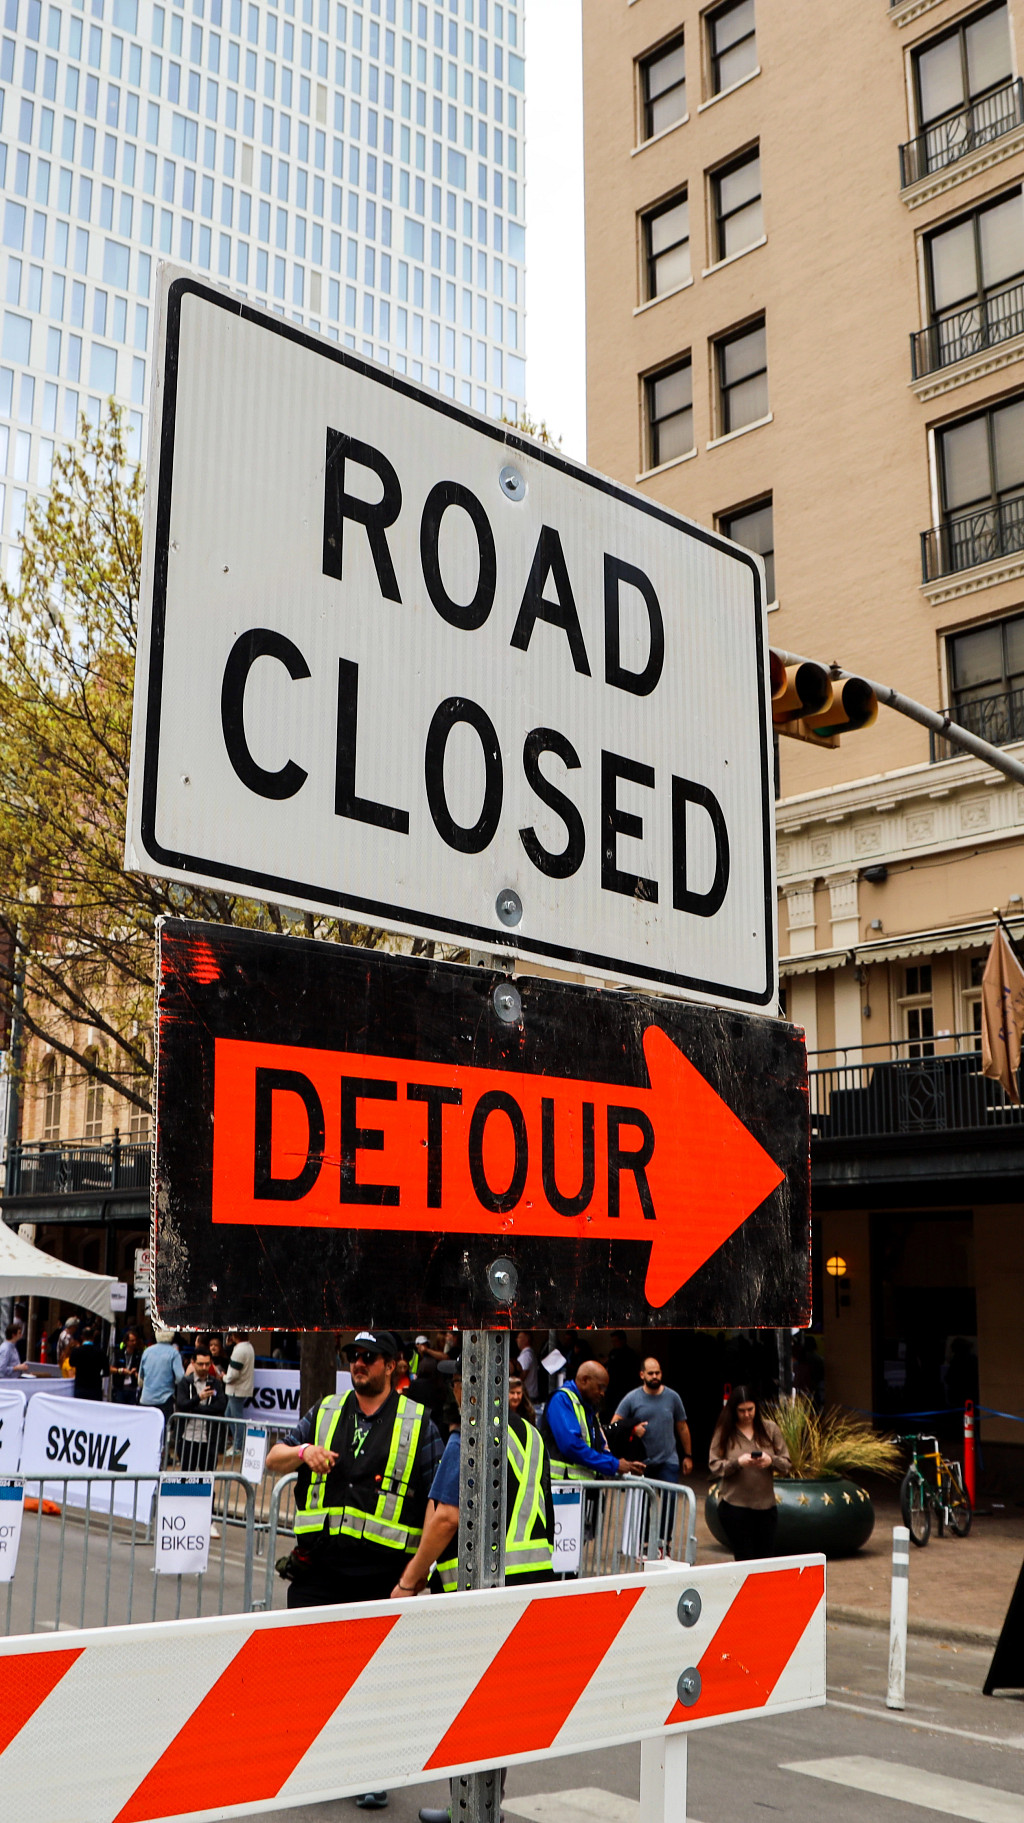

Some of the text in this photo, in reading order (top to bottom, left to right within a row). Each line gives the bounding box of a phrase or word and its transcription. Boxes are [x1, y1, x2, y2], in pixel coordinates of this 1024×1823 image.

[322, 426, 665, 697] ROAD
[221, 628, 730, 917] CLOSED
[253, 1067, 657, 1220] DETOUR
[243, 1387, 300, 1411] XSW
[46, 1425, 110, 1469] SXSW
[246, 1447, 255, 1457] NO
[244, 1459, 261, 1470] BIKES
[162, 1516, 186, 1531] NO
[554, 1522, 563, 1535] O
[161, 1535, 205, 1551] BIKES
[556, 1538, 577, 1552] KES
